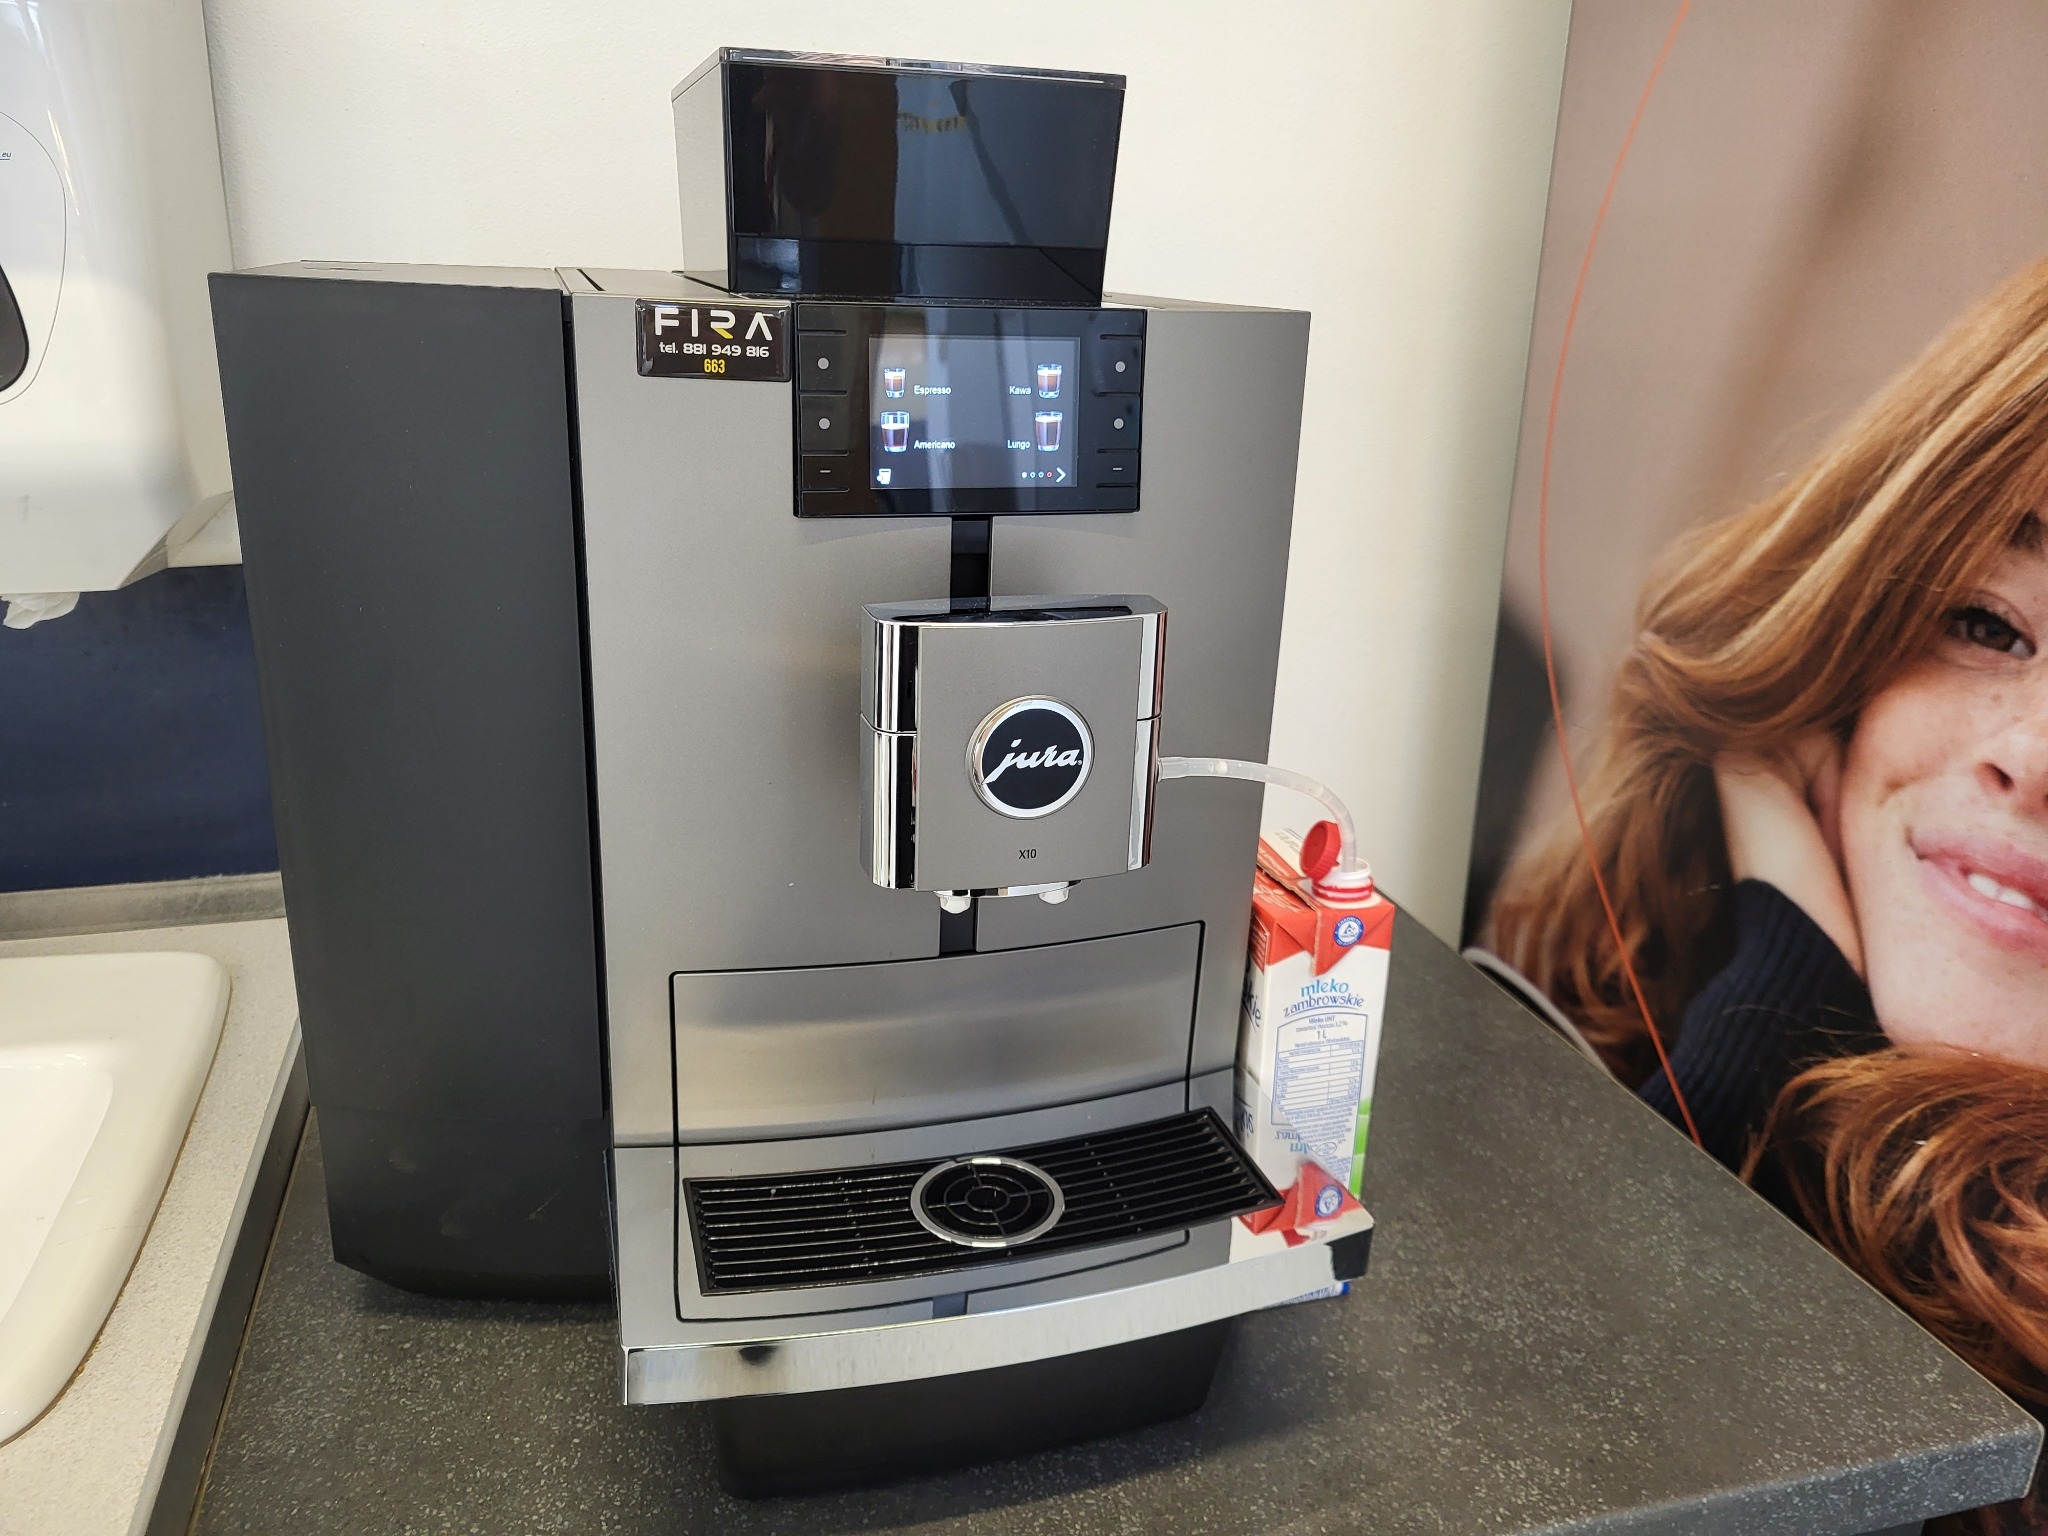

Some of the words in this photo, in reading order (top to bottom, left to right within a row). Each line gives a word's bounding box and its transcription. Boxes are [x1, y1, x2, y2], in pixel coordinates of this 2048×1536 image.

[654, 307, 773, 341] FIRA
[659, 341, 679, 354] tel.
[683, 343, 707, 355] 881
[711, 344, 742, 356] 949
[746, 346, 770, 358] 816
[704, 358, 726, 374] 663
[914, 385, 952, 396] Espresso
[1009, 386, 1031, 395] Kawa
[914, 440, 956, 449] Americano
[1007, 440, 1030, 450] Lungo
[982, 738, 1080, 784] jura
[1018, 849, 1037, 859] X10
[1301, 978, 1349, 997] mleko
[1283, 993, 1364, 1018] zambrowskie
